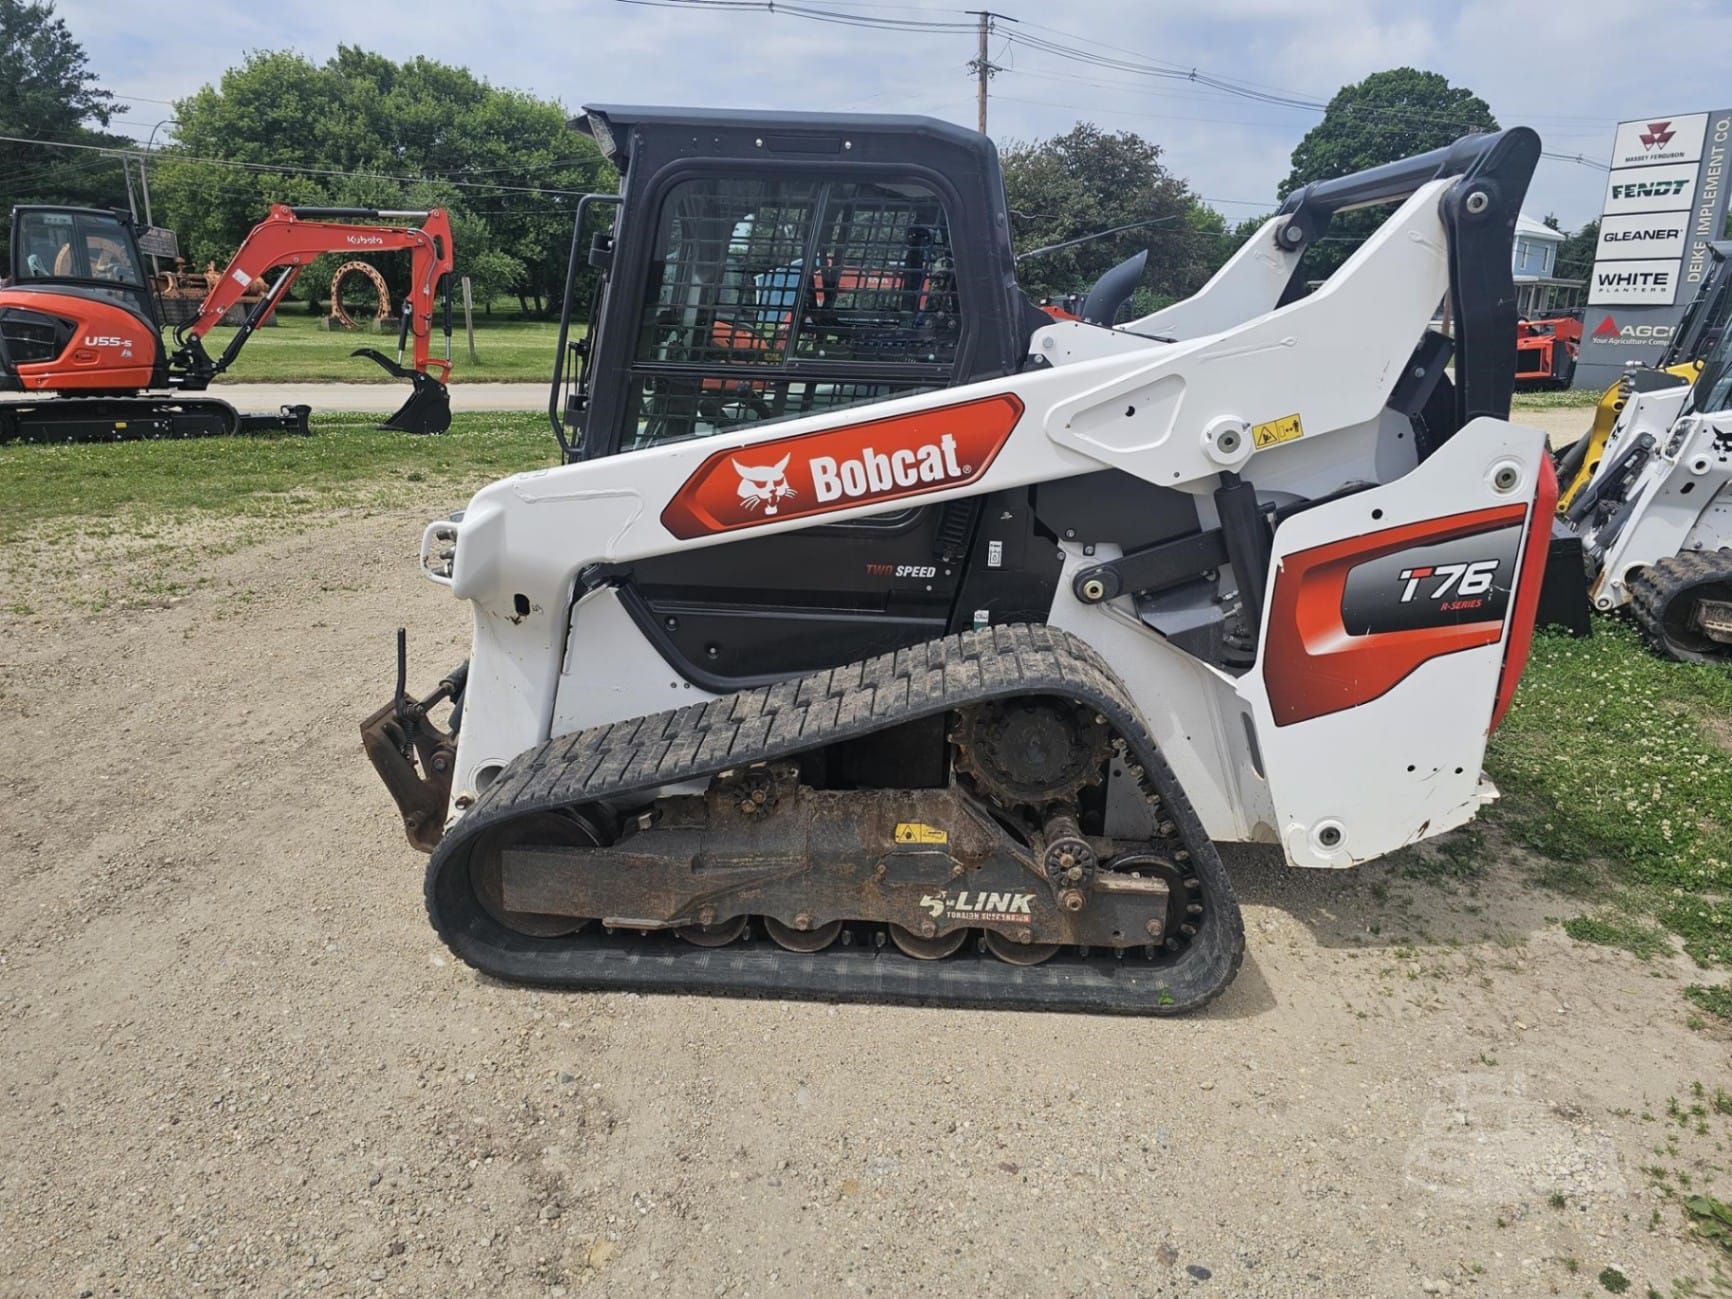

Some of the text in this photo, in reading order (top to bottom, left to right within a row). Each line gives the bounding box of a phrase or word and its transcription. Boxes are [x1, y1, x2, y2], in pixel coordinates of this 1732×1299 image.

[1612, 179, 1690, 199] FENDT
[1696, 146, 1725, 236] IMPLEMENT
[346, 235, 383, 245] Kubota
[1603, 229, 1680, 242] GLEANER
[1687, 241, 1706, 282] DEIKE
[1598, 272, 1669, 286] WHITE
[1608, 337, 1647, 346] Agriculture
[1648, 338, 1670, 346] Comp
[809, 434, 961, 502] Bobcat
[866, 564, 936, 578] TWO SPEED
[1399, 560, 1499, 603] T76
[1440, 599, 1482, 611] R-SERIES
